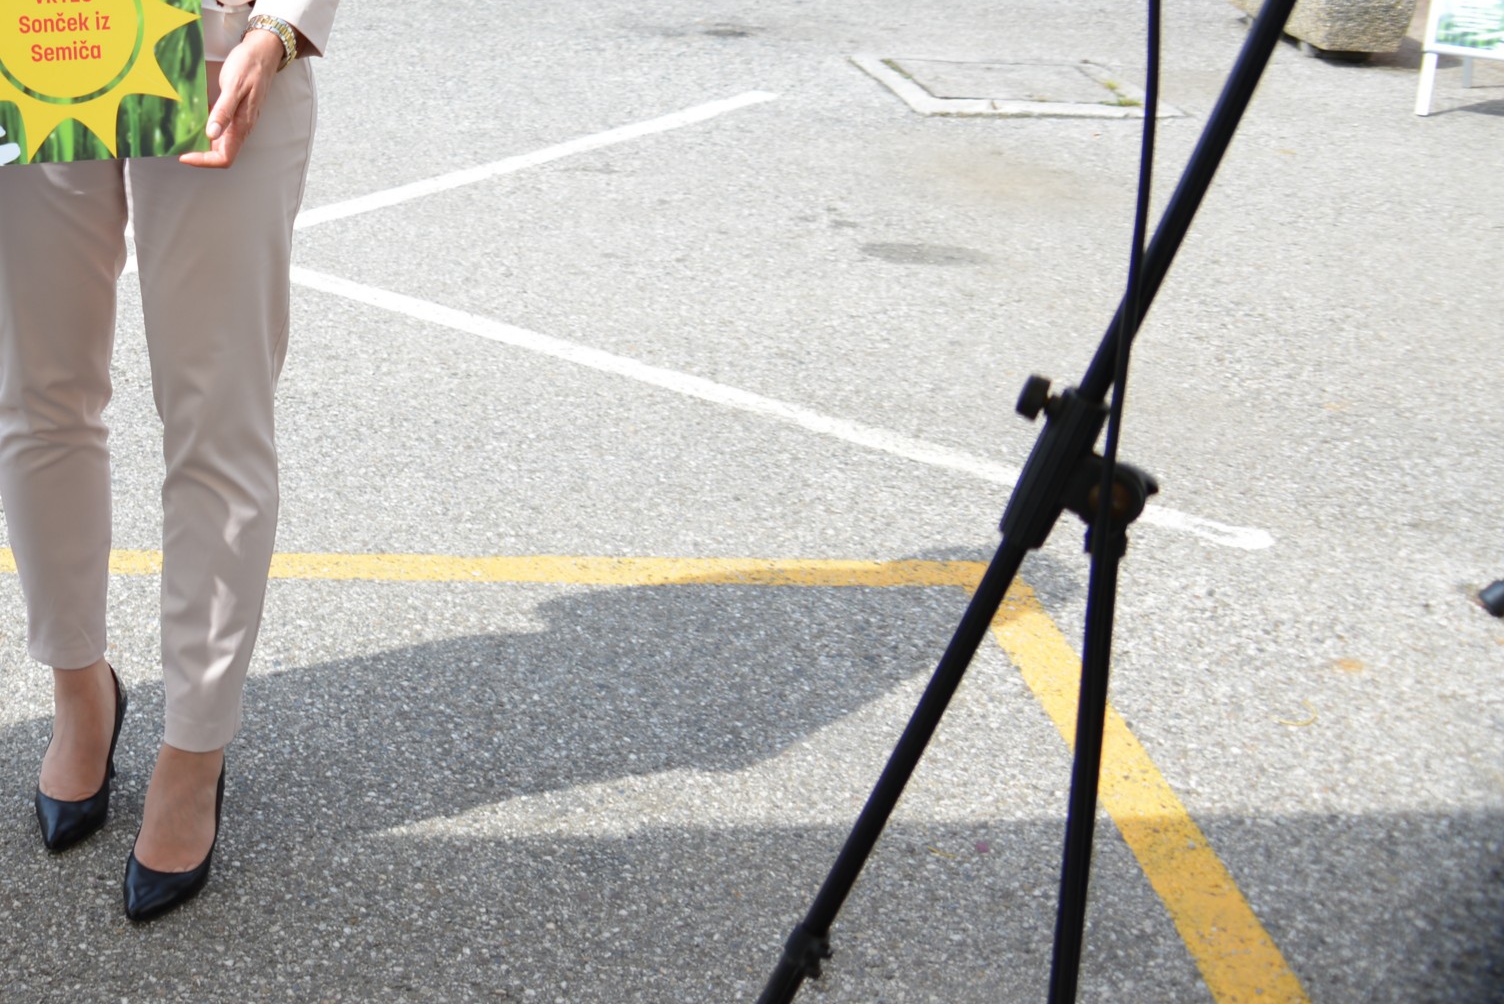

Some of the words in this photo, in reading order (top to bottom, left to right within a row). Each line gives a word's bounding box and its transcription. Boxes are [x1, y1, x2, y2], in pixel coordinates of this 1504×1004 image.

[18, 11, 90, 34] Sonček
[94, 10, 111, 32] iz
[30, 39, 102, 63] Semiča
